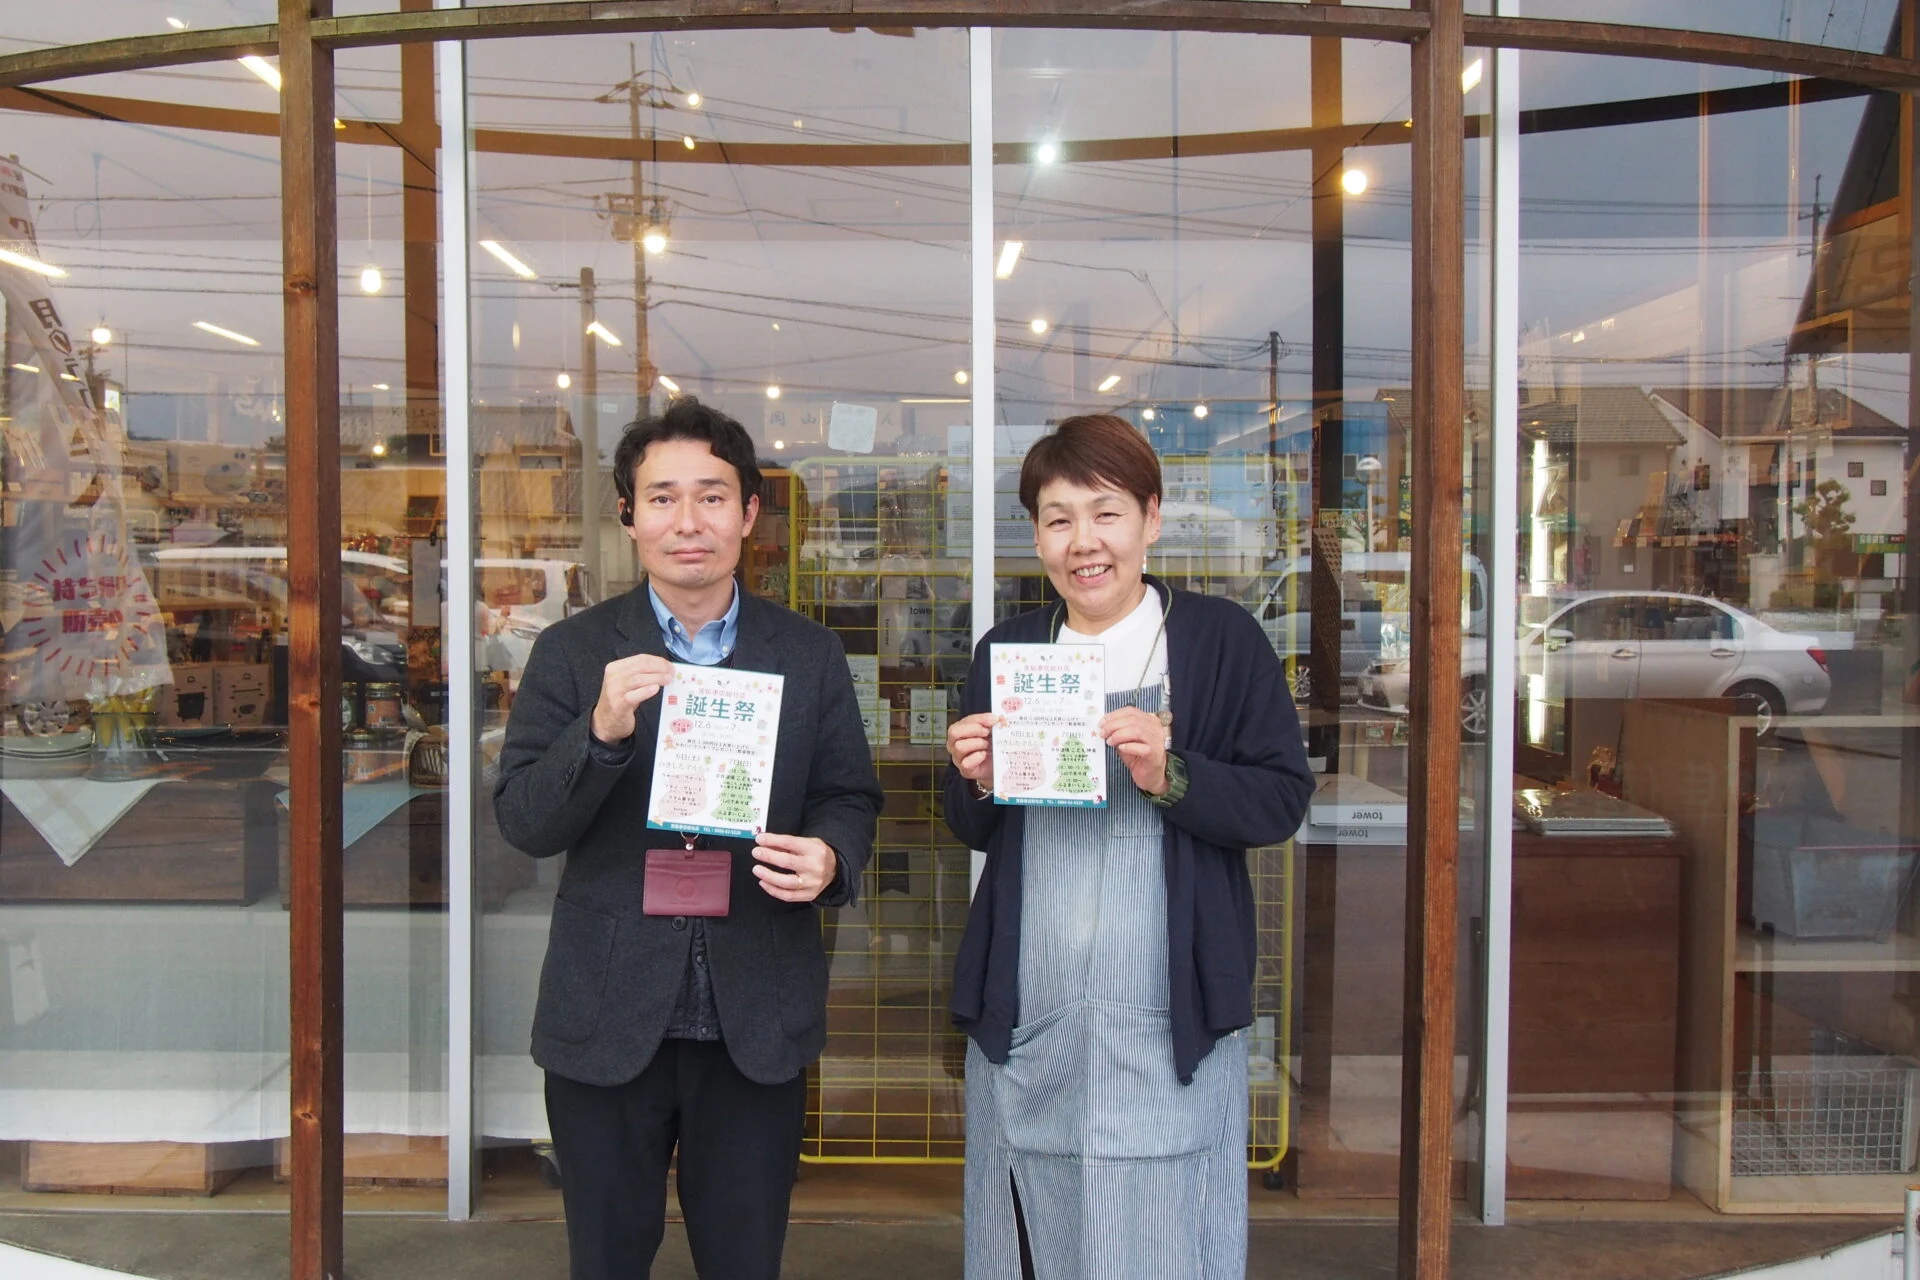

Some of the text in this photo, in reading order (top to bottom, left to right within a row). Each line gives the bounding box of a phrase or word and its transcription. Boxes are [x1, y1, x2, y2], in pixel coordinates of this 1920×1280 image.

[1013, 672, 1080, 693] 誕生祭
[685, 694, 755, 721] 誕生祭
[1352, 812, 1383, 820] tower
